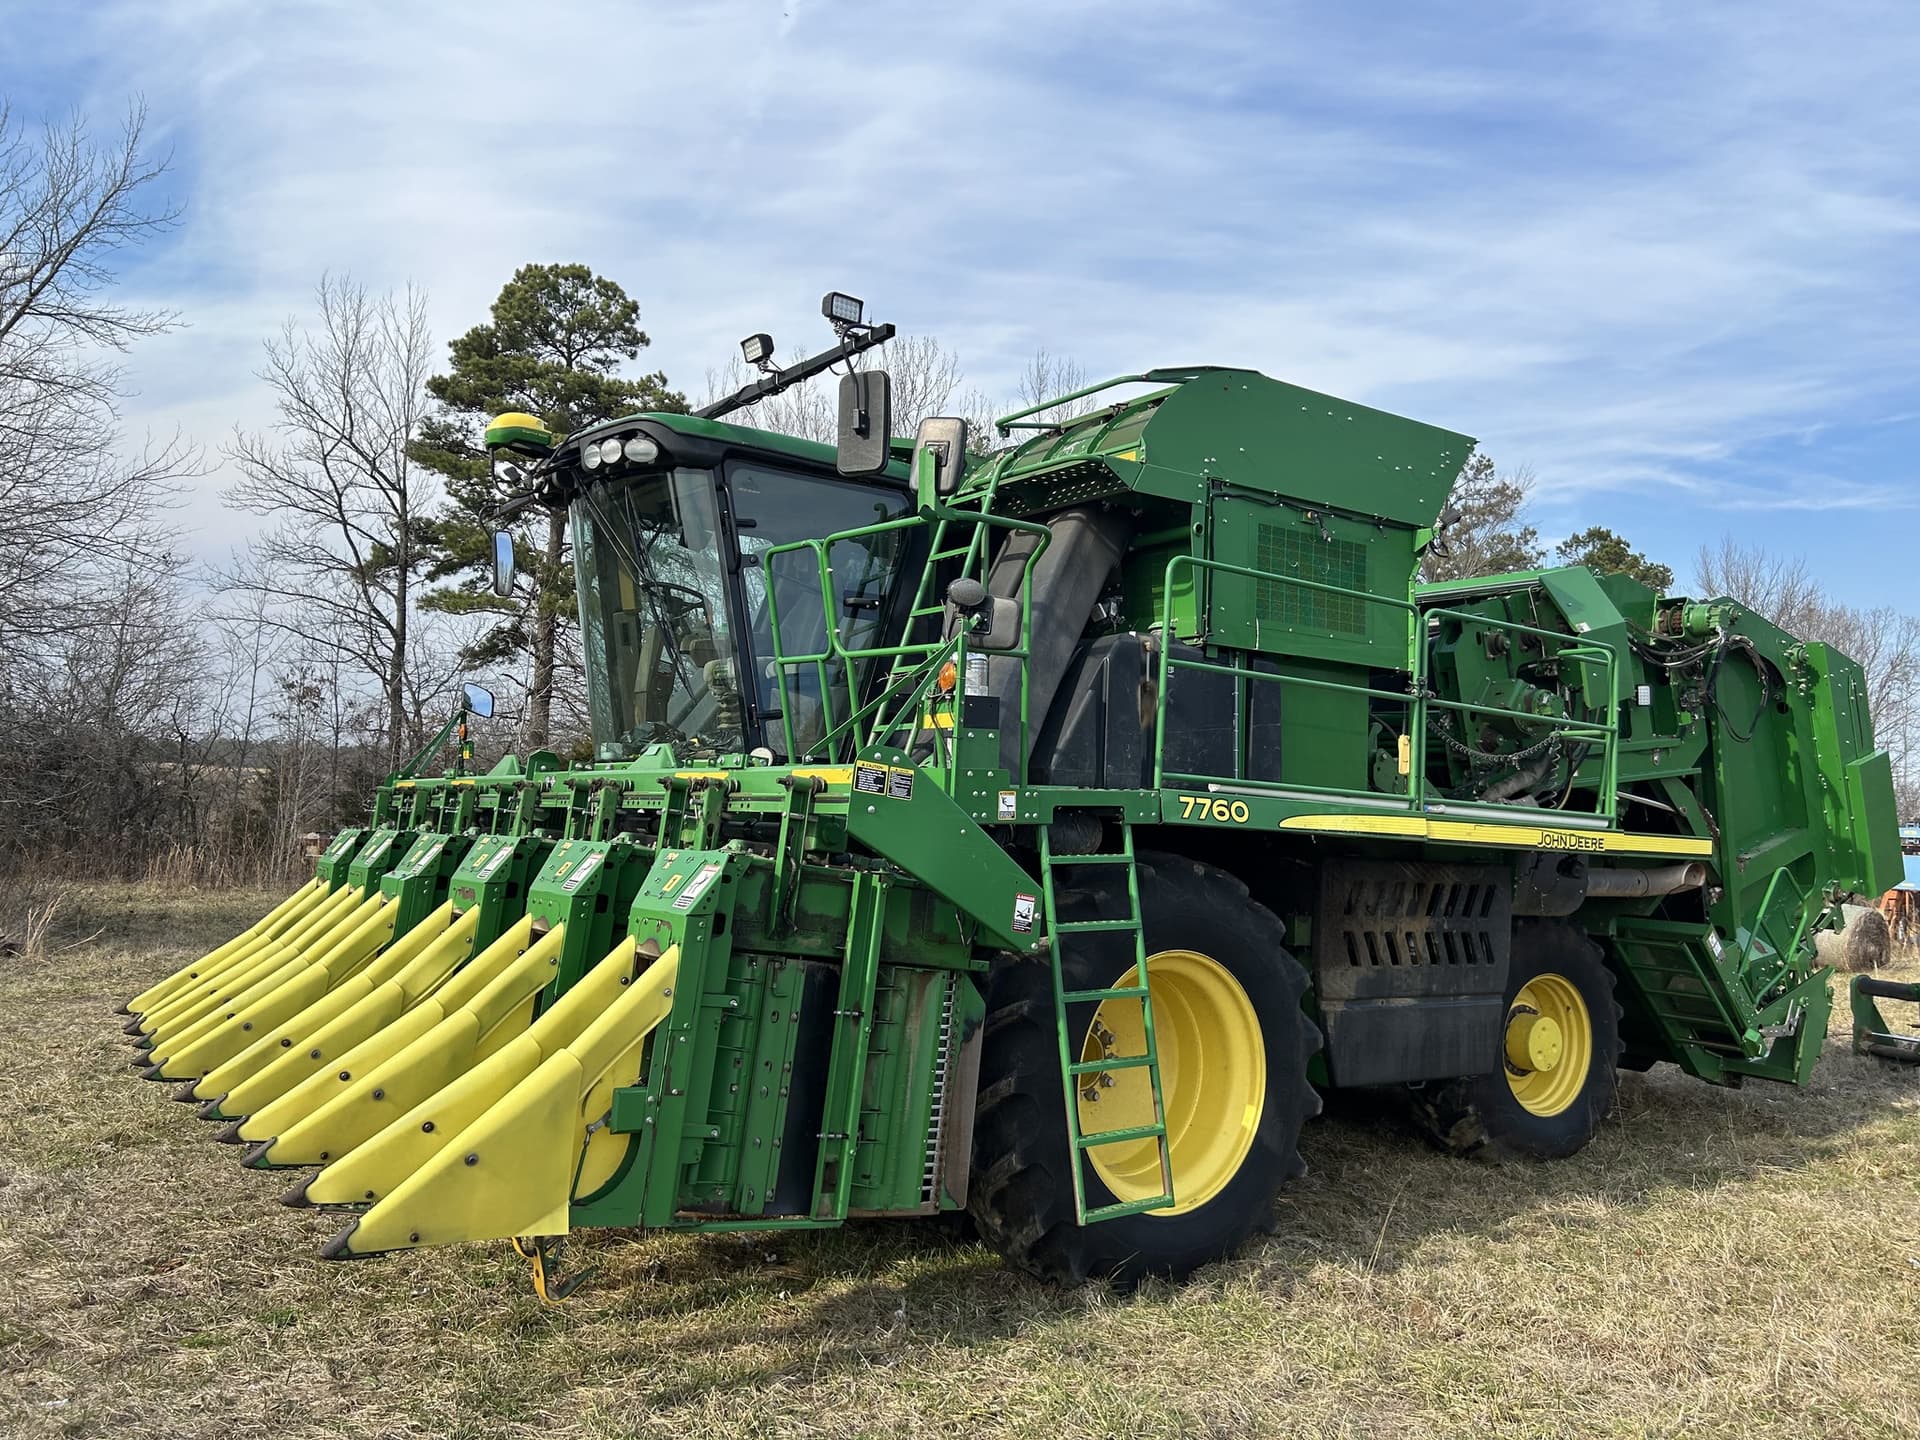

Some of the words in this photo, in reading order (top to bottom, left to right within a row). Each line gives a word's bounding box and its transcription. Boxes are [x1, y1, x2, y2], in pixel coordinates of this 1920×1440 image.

[1178, 795, 1250, 823] 7760
[1537, 832, 1568, 847] JOHN
[1569, 834, 1605, 849] DEERE
